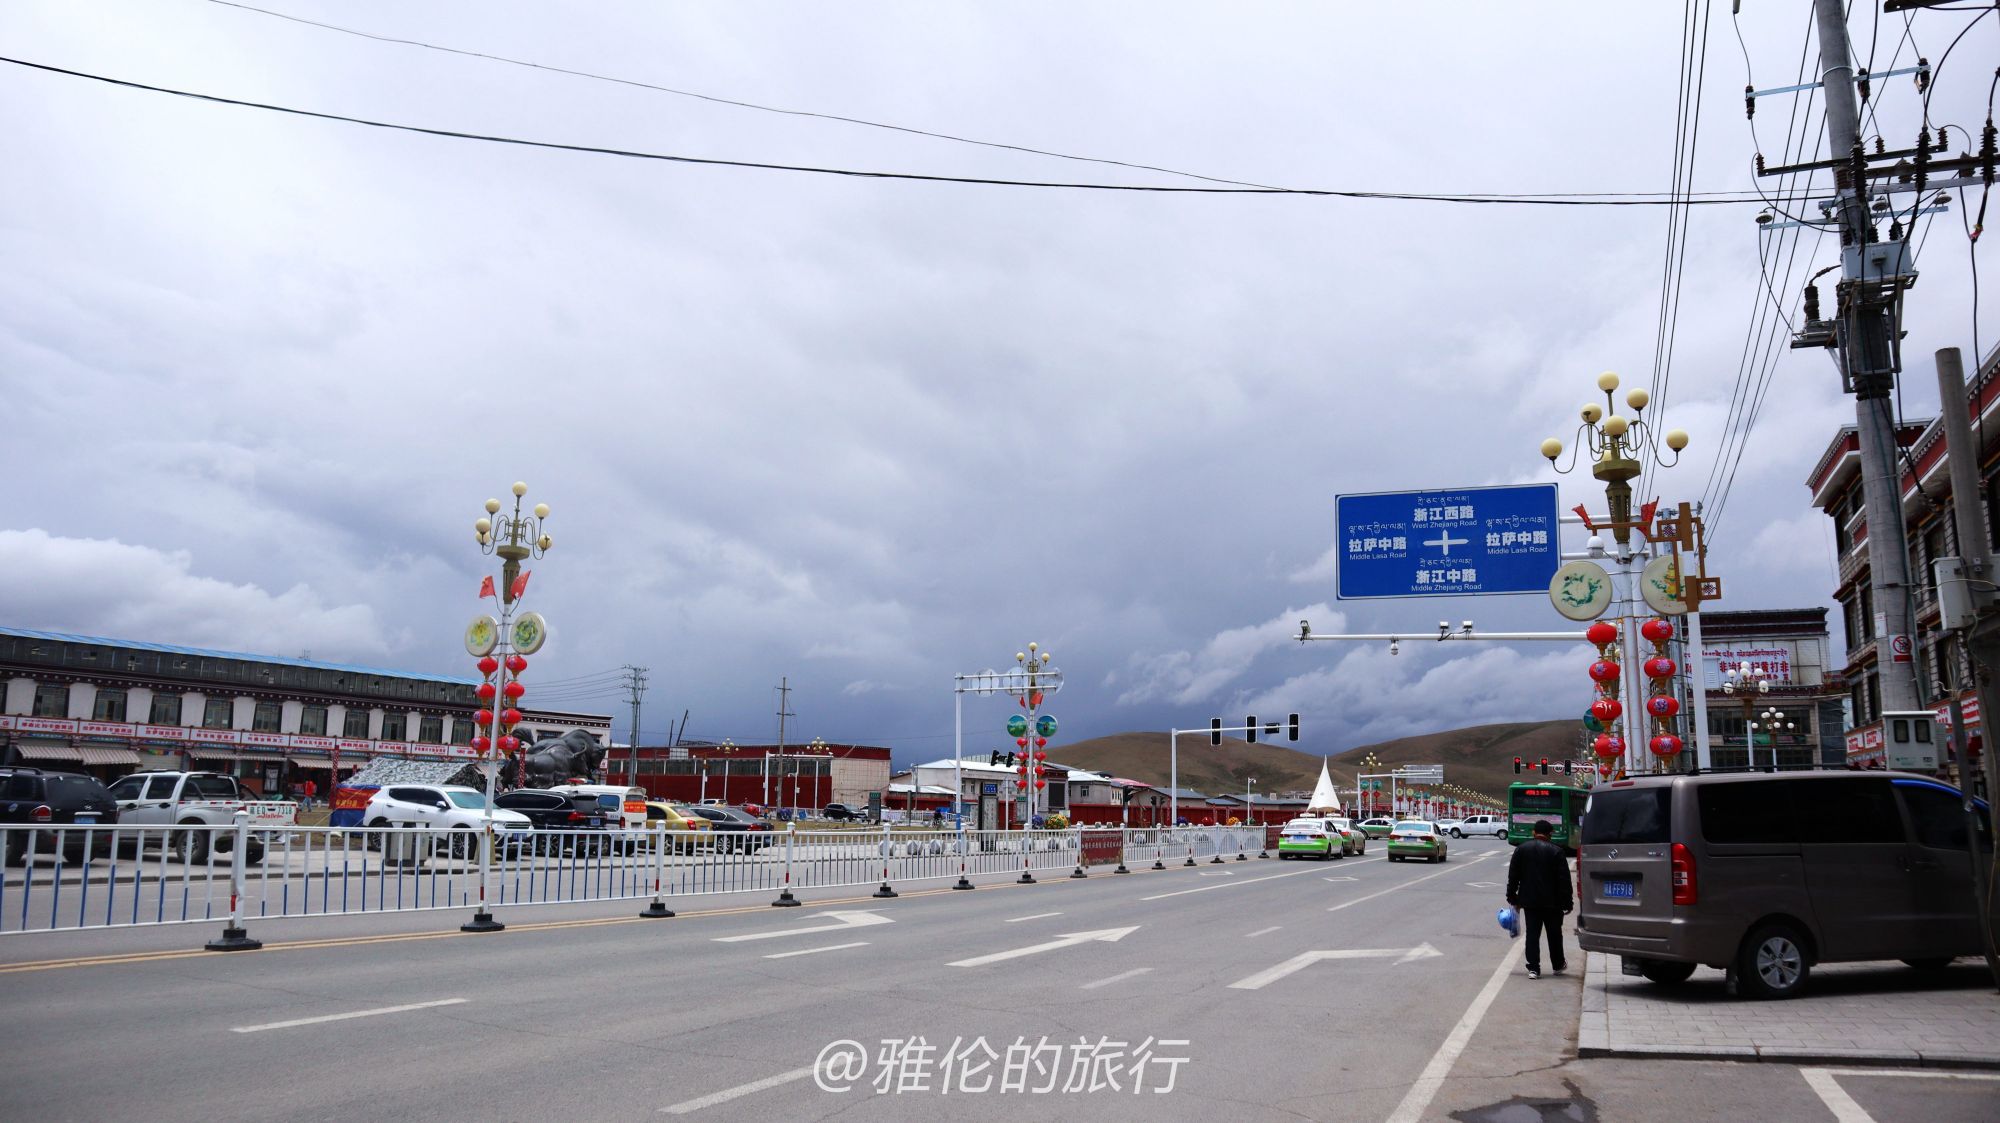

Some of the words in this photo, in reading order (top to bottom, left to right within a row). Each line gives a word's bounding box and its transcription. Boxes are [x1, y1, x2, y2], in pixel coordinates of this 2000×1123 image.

[1414, 505, 1474, 522] 浙江西路
[1430, 521, 1458, 529] Zhejiang
[1460, 519, 1478, 527] Road
[1348, 537, 1407, 553] 拉萨中路
[1486, 530, 1548, 547] 拉萨中路
[1389, 551, 1407, 559] Road
[1487, 547, 1510, 555] Middle
[1416, 568, 1477, 584] 浙江中路
[1434, 583, 1463, 592] Zhejiang
